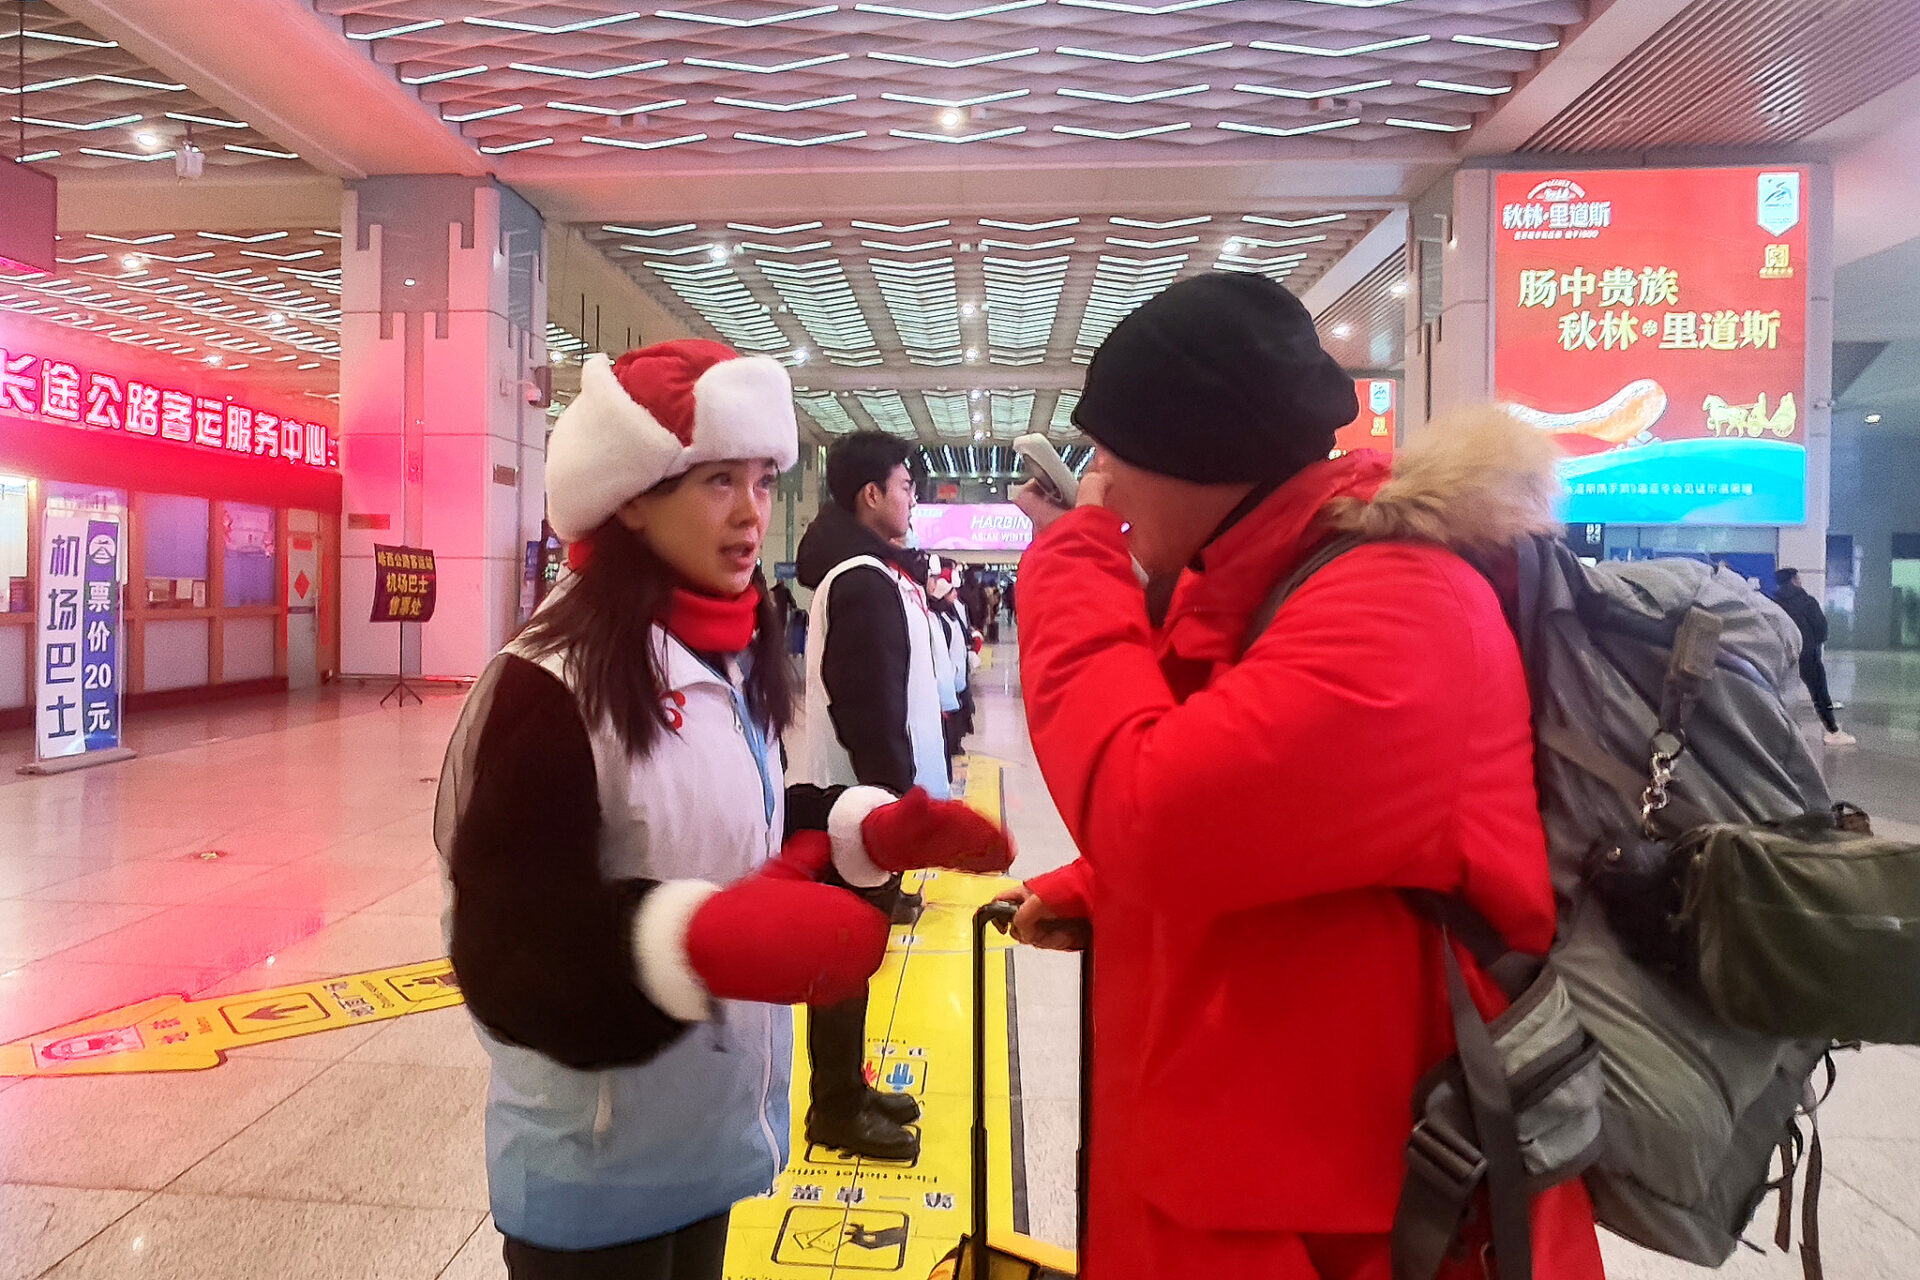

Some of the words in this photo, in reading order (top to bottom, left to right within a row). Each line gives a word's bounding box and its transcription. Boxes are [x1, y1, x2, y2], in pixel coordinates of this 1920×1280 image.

[1518, 266, 1679, 307] 肠中贵族
[0, 351, 338, 466] 长途公路客运服务中心
[971, 515, 1029, 529] HARBIN
[1001, 532, 1032, 543] WINTE
[386, 572, 428, 593] 机场巴士
[46, 534, 80, 738] 机场巴士
[84, 582, 111, 732] 票价20元
